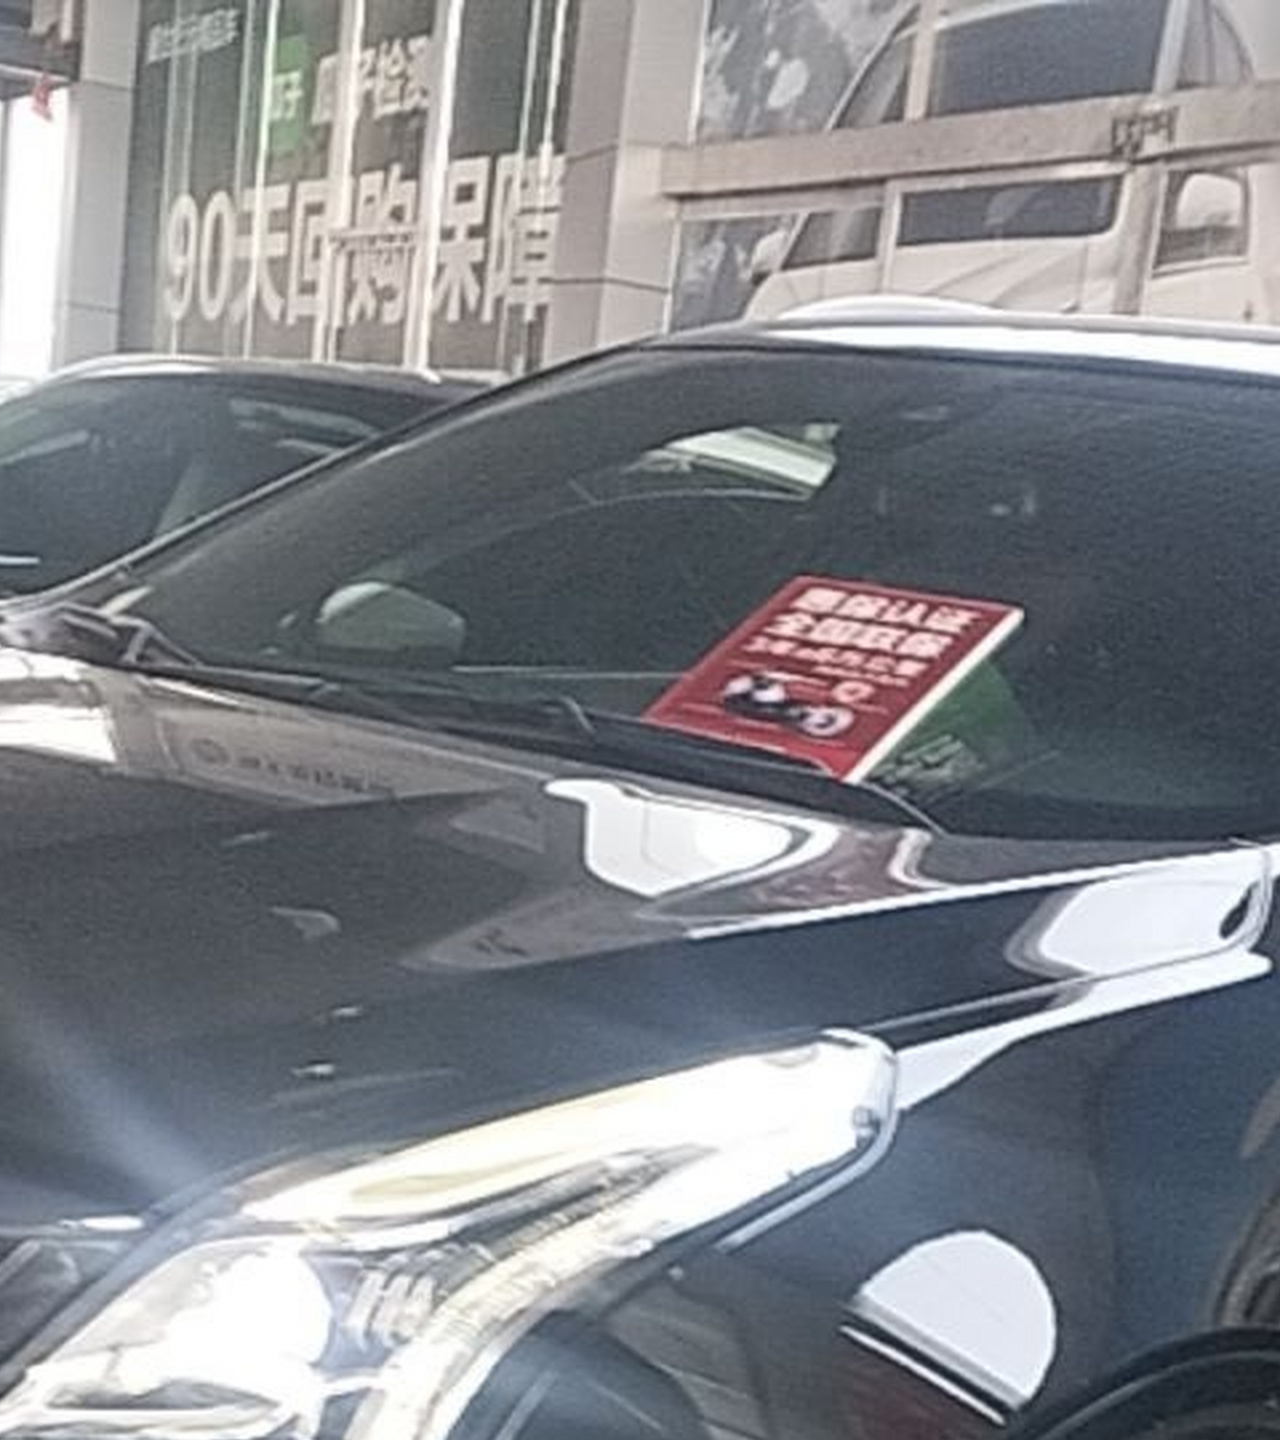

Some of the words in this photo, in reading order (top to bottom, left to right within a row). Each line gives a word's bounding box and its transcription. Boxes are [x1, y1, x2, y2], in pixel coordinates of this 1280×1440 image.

[163, 150, 566, 326] 90天回购保障
